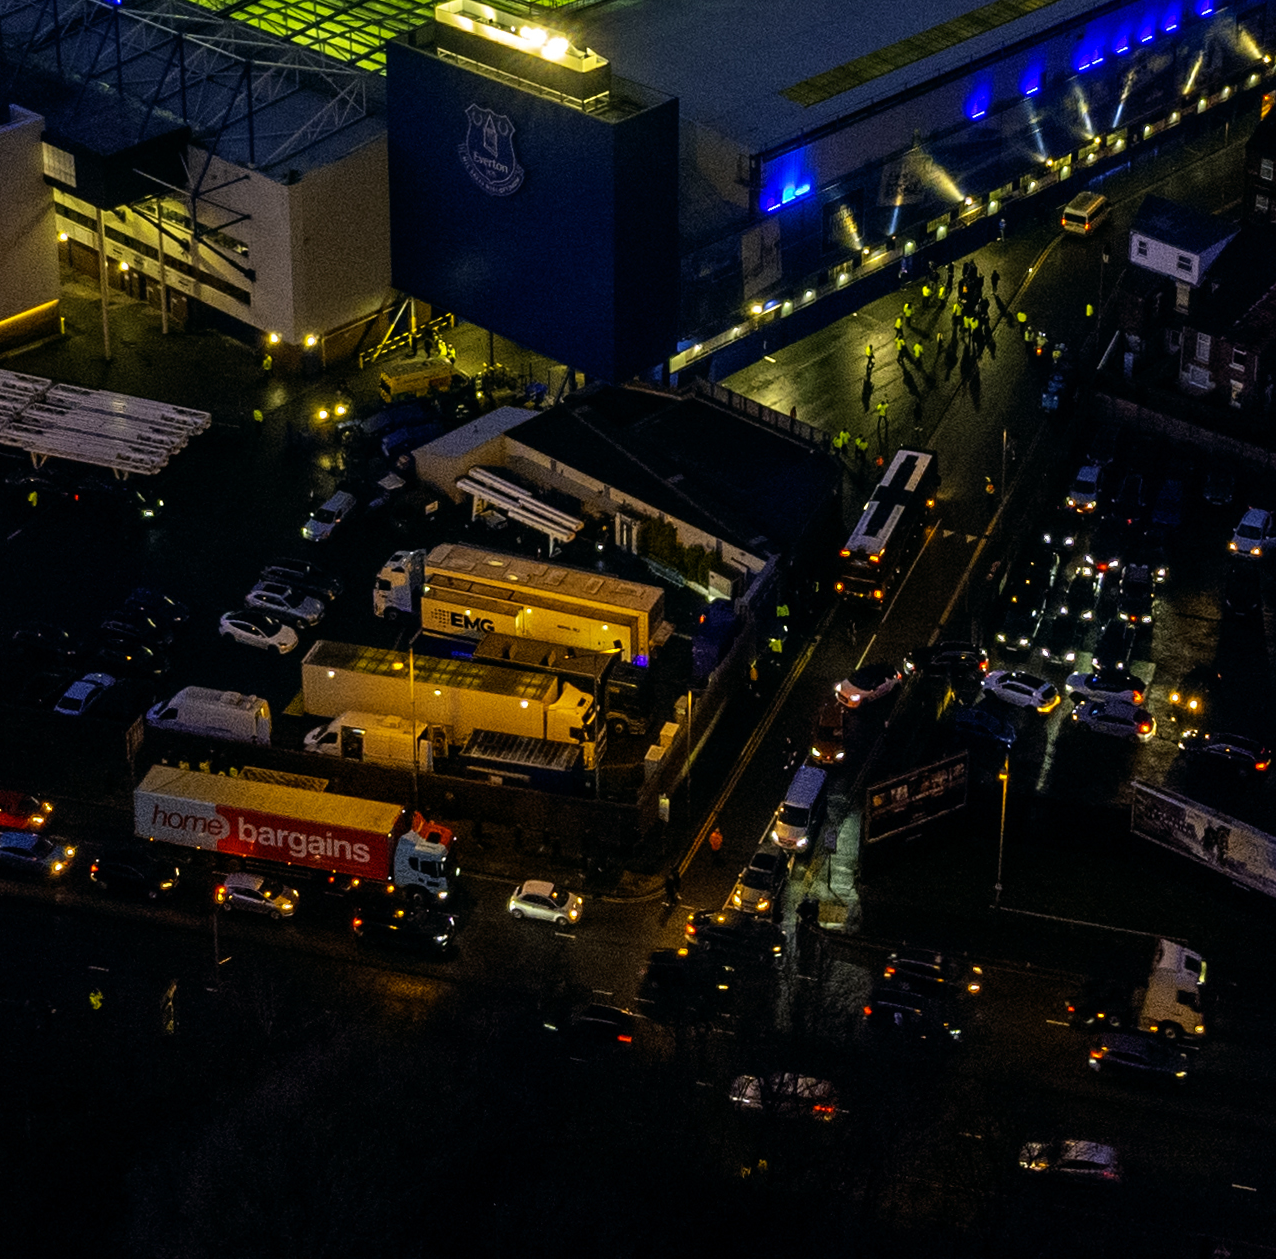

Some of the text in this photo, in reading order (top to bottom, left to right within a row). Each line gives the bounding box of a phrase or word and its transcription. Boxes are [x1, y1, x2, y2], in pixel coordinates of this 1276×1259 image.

[472, 150, 510, 175] Everton
[450, 612, 495, 633] EMG
[151, 804, 371, 864] home bargains
